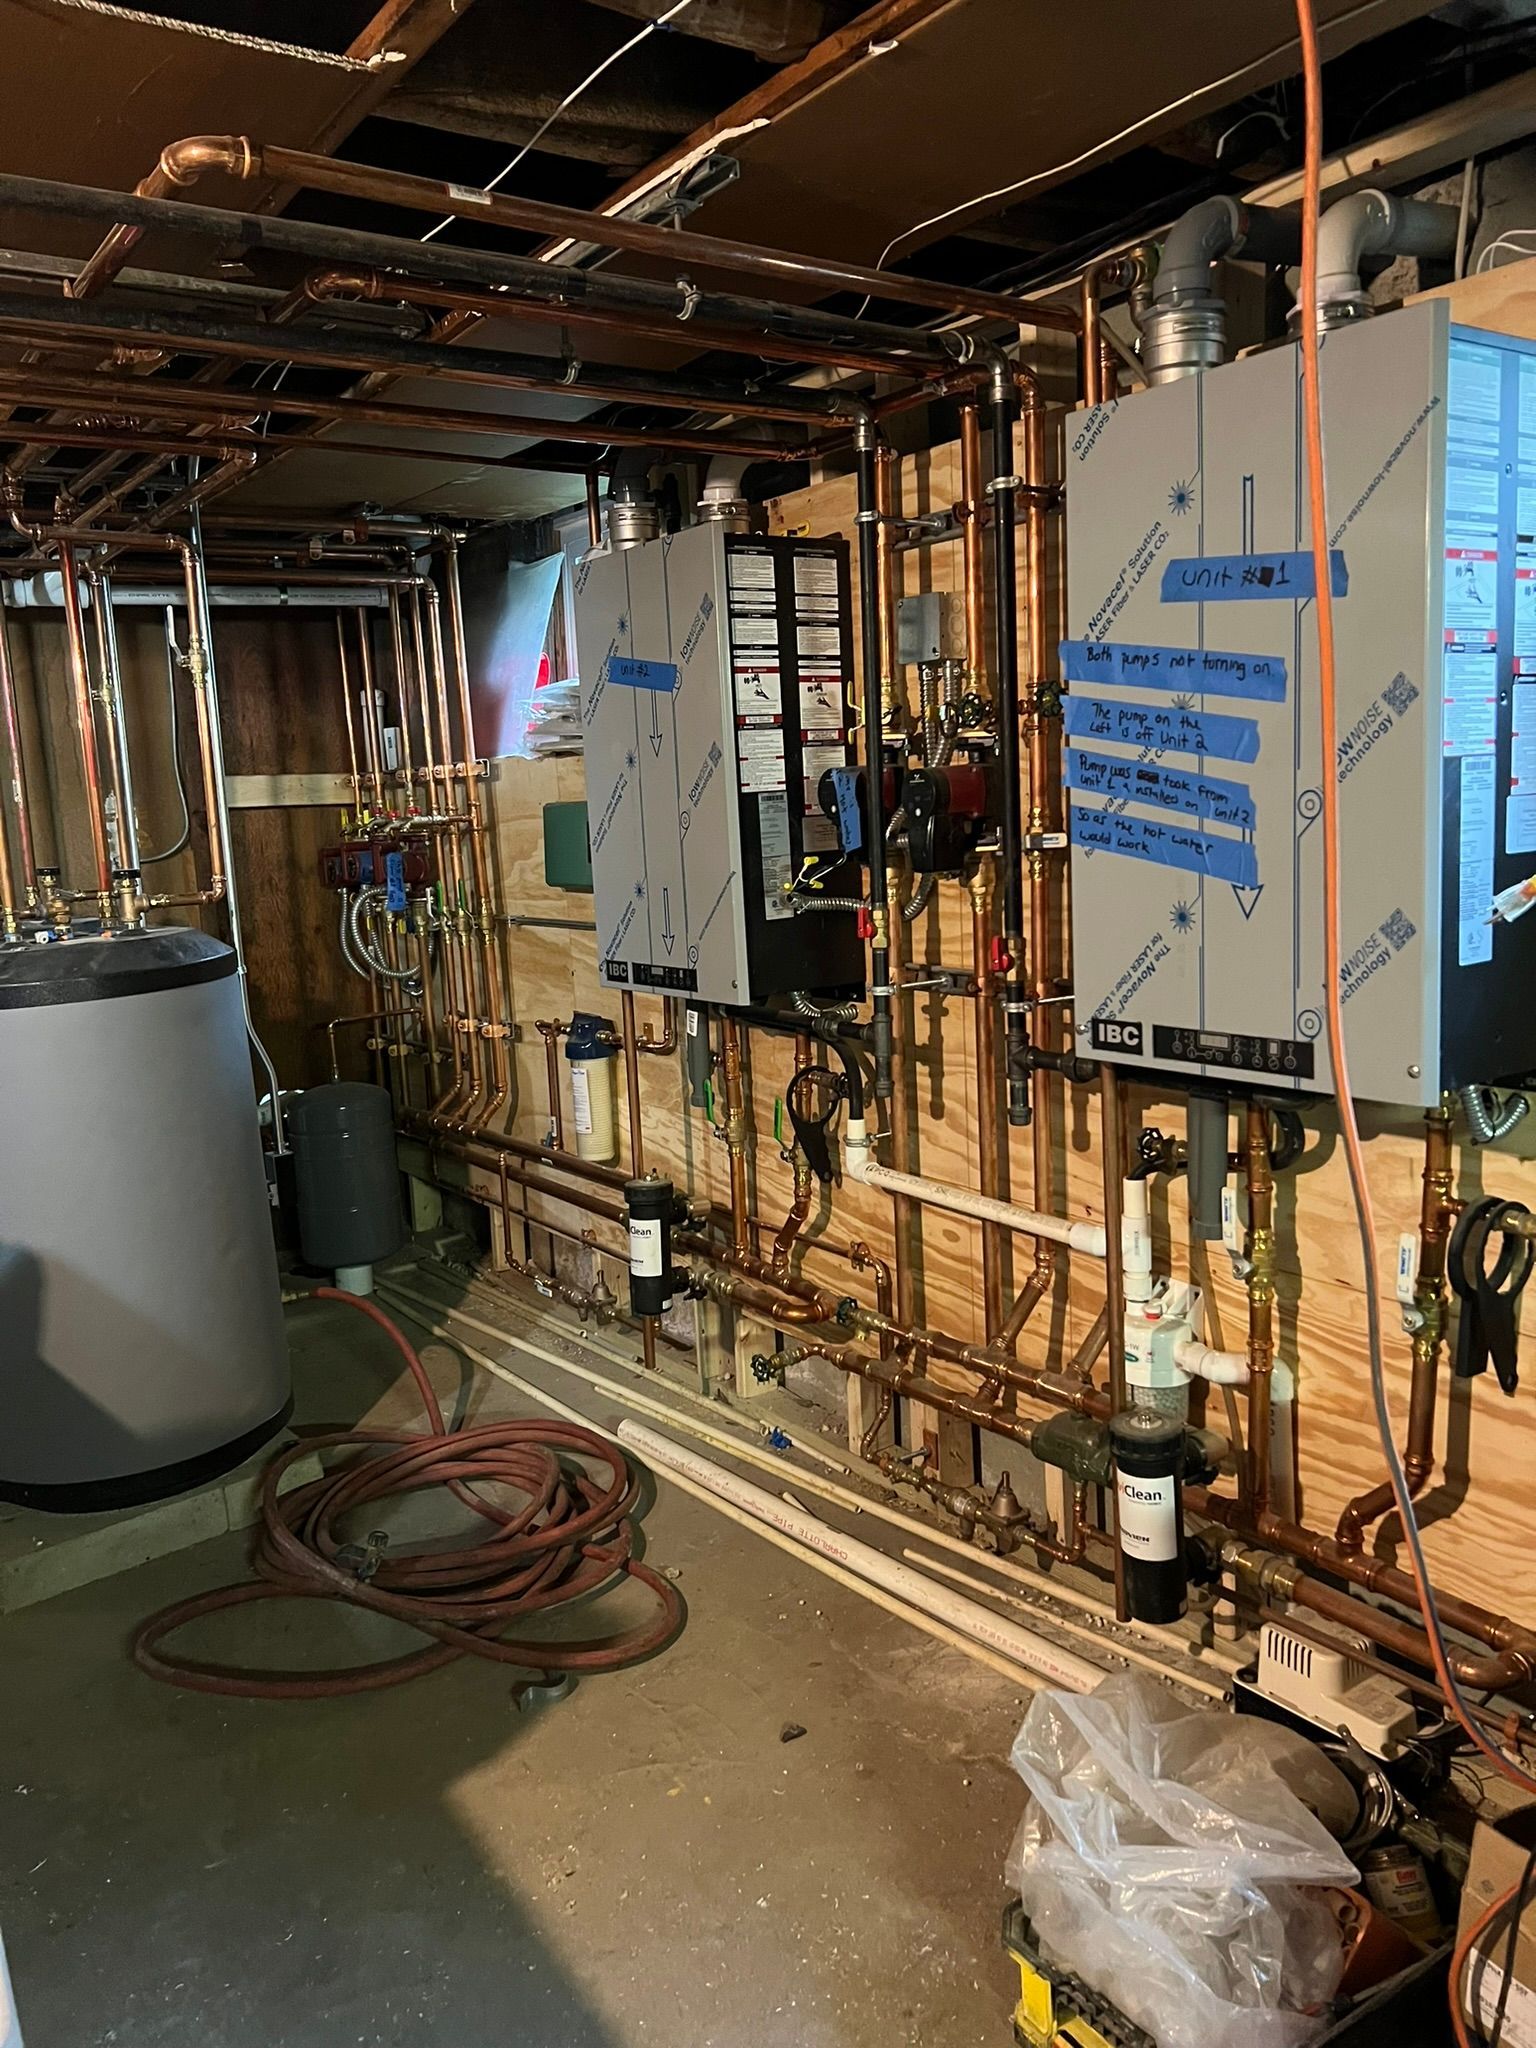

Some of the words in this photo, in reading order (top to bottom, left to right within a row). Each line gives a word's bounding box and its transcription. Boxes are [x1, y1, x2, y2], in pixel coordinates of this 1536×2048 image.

[1083, 404, 1102, 432] ASER
[1079, 412, 1110, 461] Solution
[1128, 520, 1162, 569] Solution
[1094, 616, 1114, 643] ASER
[1132, 550, 1157, 584] LASER
[1086, 646, 1112, 662] Both
[1122, 651, 1160, 674] pumps
[1169, 655, 1196, 669] not
[1202, 655, 1246, 681] turning
[1091, 702, 1112, 720] The
[1118, 708, 1148, 727] pump
[1155, 713, 1170, 725] on
[1179, 715, 1202, 730] the
[1135, 727, 1154, 740] off
[1194, 734, 1209, 751] 2
[1079, 753, 1107, 778] Pump
[1110, 766, 1131, 780] was
[1163, 774, 1191, 792] took
[1184, 800, 1199, 812] on
[1239, 809, 1250, 824] 2
[1079, 830, 1111, 845] would
[1117, 837, 1151, 854] work
[1092, 814, 1108, 826] as
[1114, 818, 1135, 836] the
[1143, 824, 1166, 840] hot
[1172, 834, 1214, 856] water
[1130, 945, 1153, 973] LASER
[1153, 944, 1171, 962] The
[1339, 932, 1381, 982] WNOISE
[609, 963, 627, 976] IBC
[1098, 1023, 1140, 1046] IBC
[772, 1514, 794, 1530] PIPE
[799, 1526, 849, 1561] CHARLOTTE
